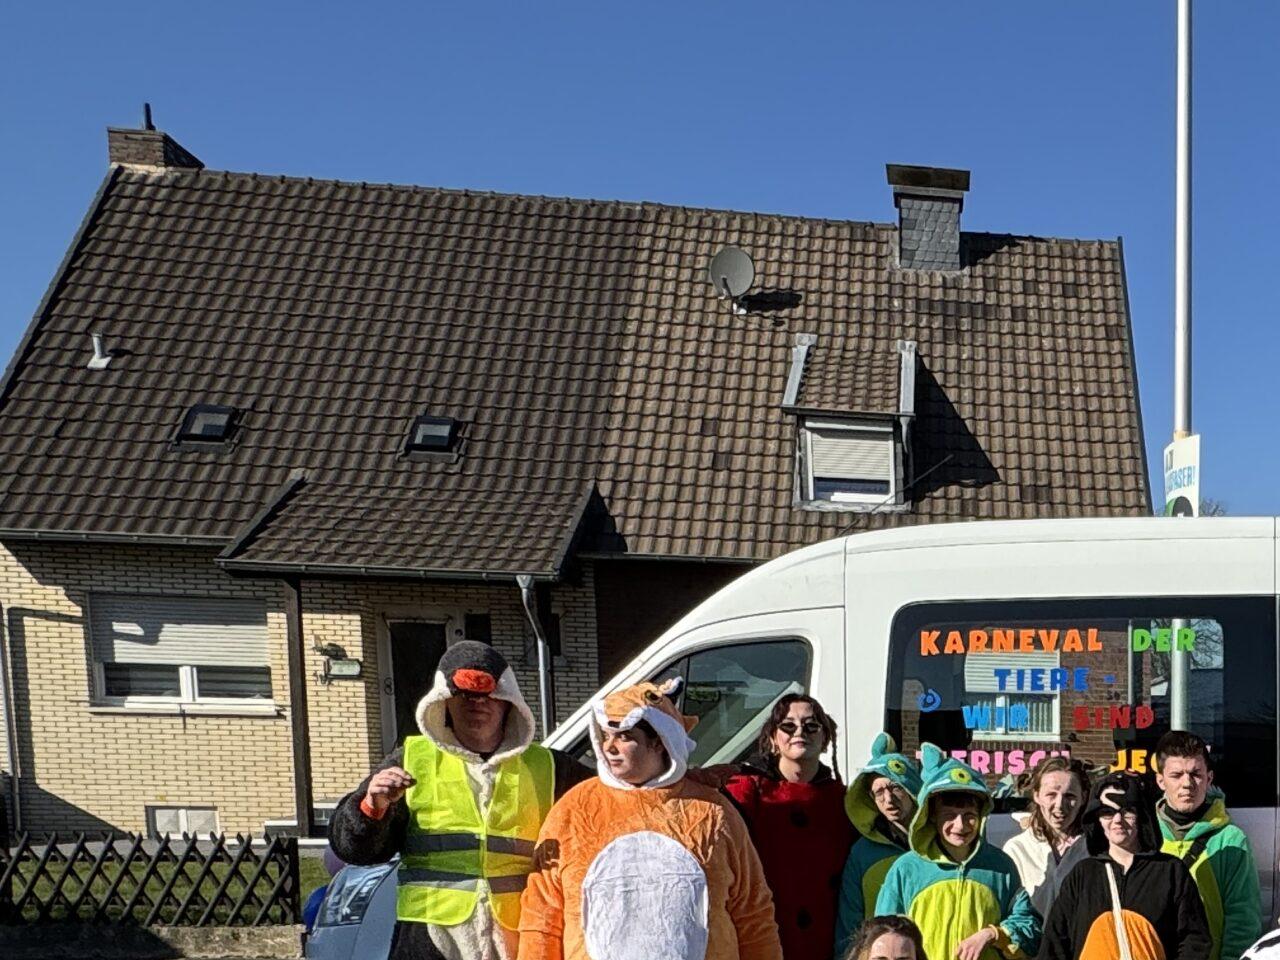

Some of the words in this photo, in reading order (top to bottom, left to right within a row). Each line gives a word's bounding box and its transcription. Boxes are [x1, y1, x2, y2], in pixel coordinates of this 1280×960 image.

[920, 628, 1103, 657] KARNEVAL
[1132, 628, 1196, 653] DER
[993, 666, 1089, 692] TIERE
[961, 703, 1030, 731] WIR
[1071, 704, 1155, 731] SIND
